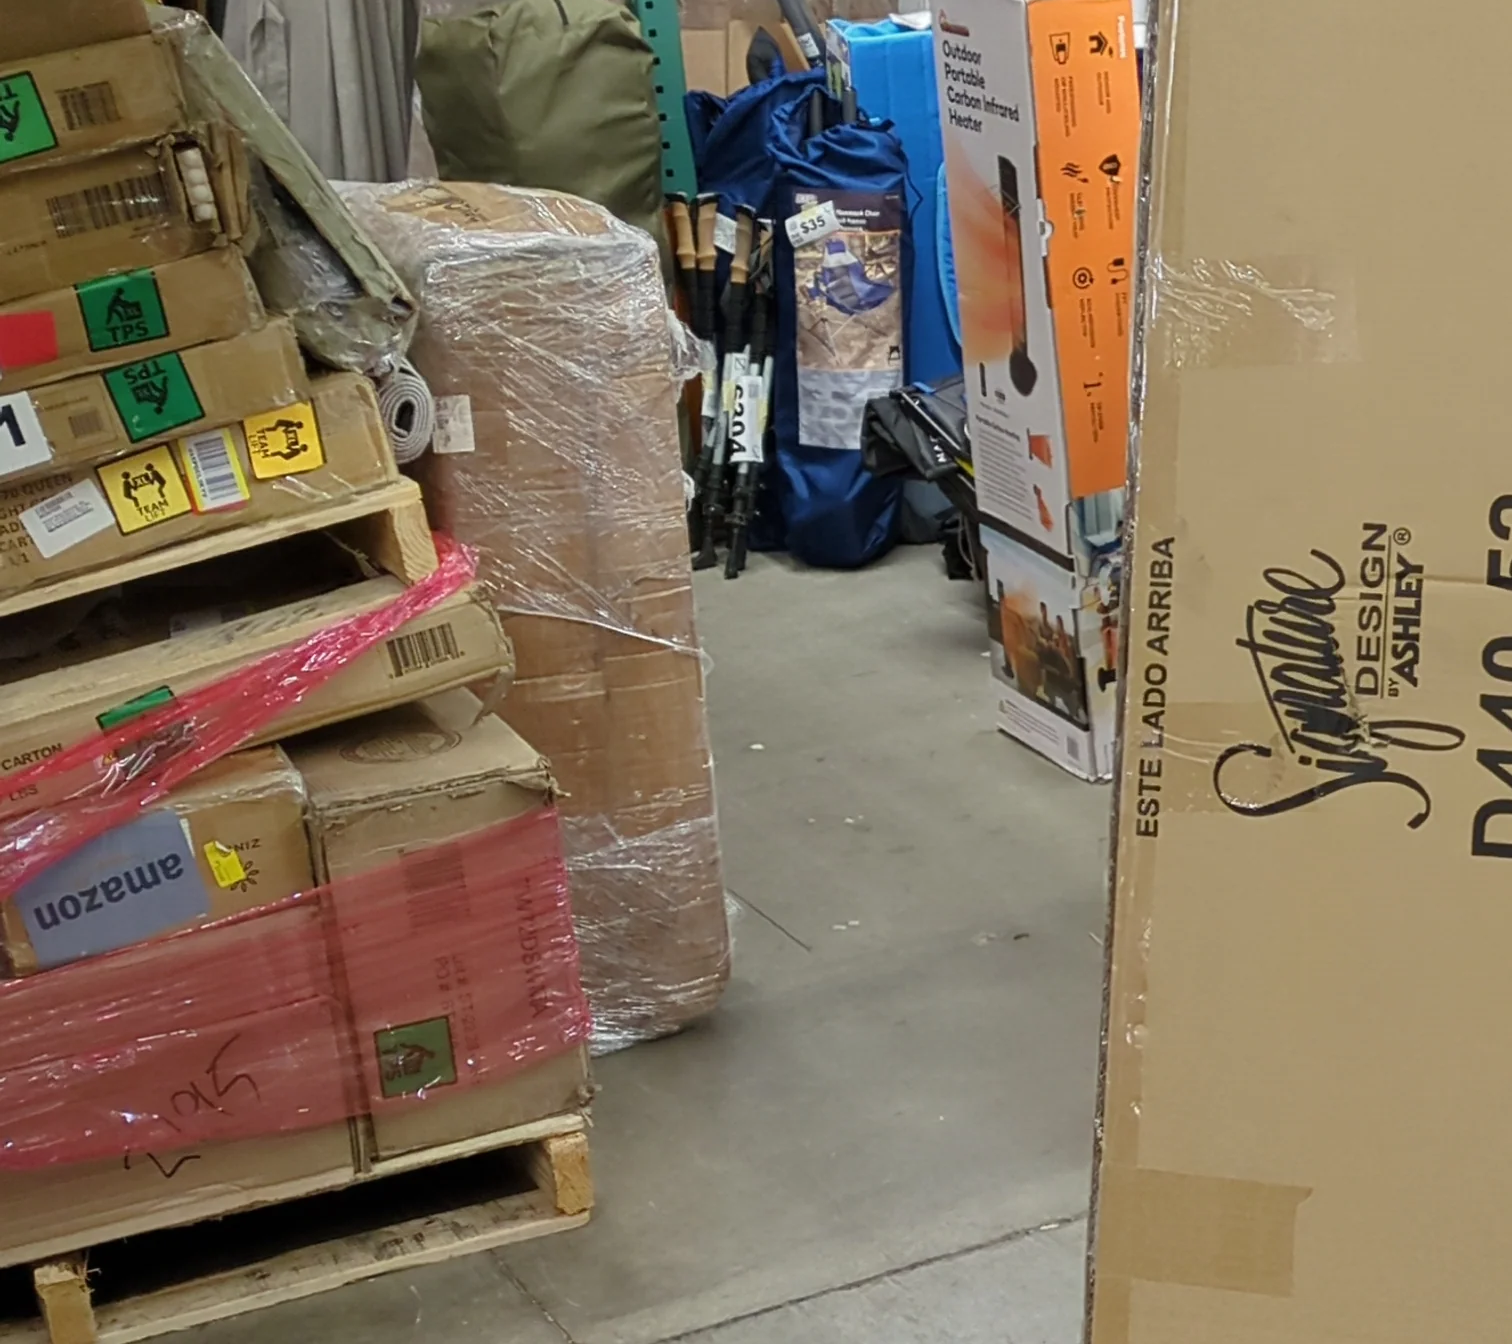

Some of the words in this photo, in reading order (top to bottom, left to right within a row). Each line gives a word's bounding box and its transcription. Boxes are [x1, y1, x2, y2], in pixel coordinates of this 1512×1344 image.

[942, 39, 982, 65] Outdoor
[944, 61, 986, 90] Portable
[947, 85, 983, 111] Carbon
[982, 94, 1020, 123] Infrared
[948, 107, 983, 134] Heater
[800, 215, 826, 235] $35
[107, 320, 149, 343] TPS
[123, 359, 167, 385] TPS
[257, 428, 271, 459] TEAM
[23, 472, 73, 493] QUEEN
[136, 499, 170, 518] TEAM
[1148, 536, 1176, 656] ARRIBA
[1356, 522, 1388, 697] DESIGN
[1390, 552, 1425, 688] ASHLEY
[1213, 549, 1466, 830] Signature
[1388, 678, 1401, 698] BY
[1143, 662, 1168, 749] LADO
[1, 742, 63, 772] CARTON
[1136, 758, 1163, 838] ESTE
[33, 852, 185, 931] amazon
